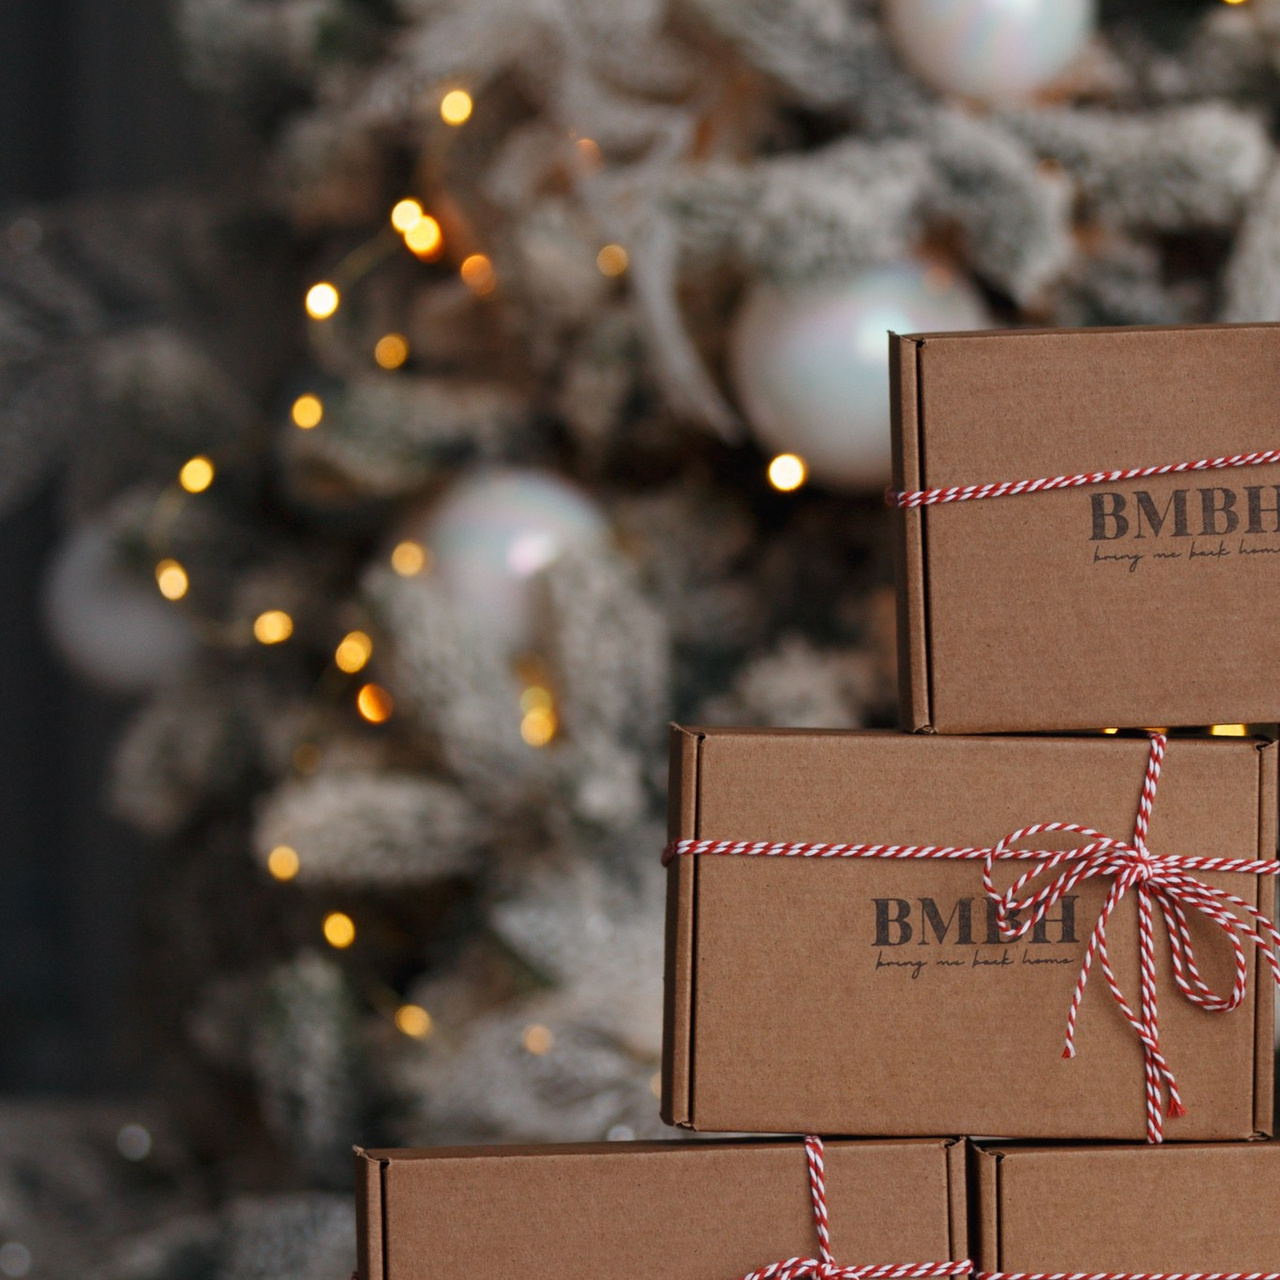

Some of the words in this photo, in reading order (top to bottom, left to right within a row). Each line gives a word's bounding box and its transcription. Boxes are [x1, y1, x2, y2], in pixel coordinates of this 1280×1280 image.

[1093, 545, 1144, 573] bring
[1153, 550, 1182, 559] me
[1189, 540, 1230, 562] back
[871, 895, 1080, 946] BMBH
[972, 949, 1014, 968] back
